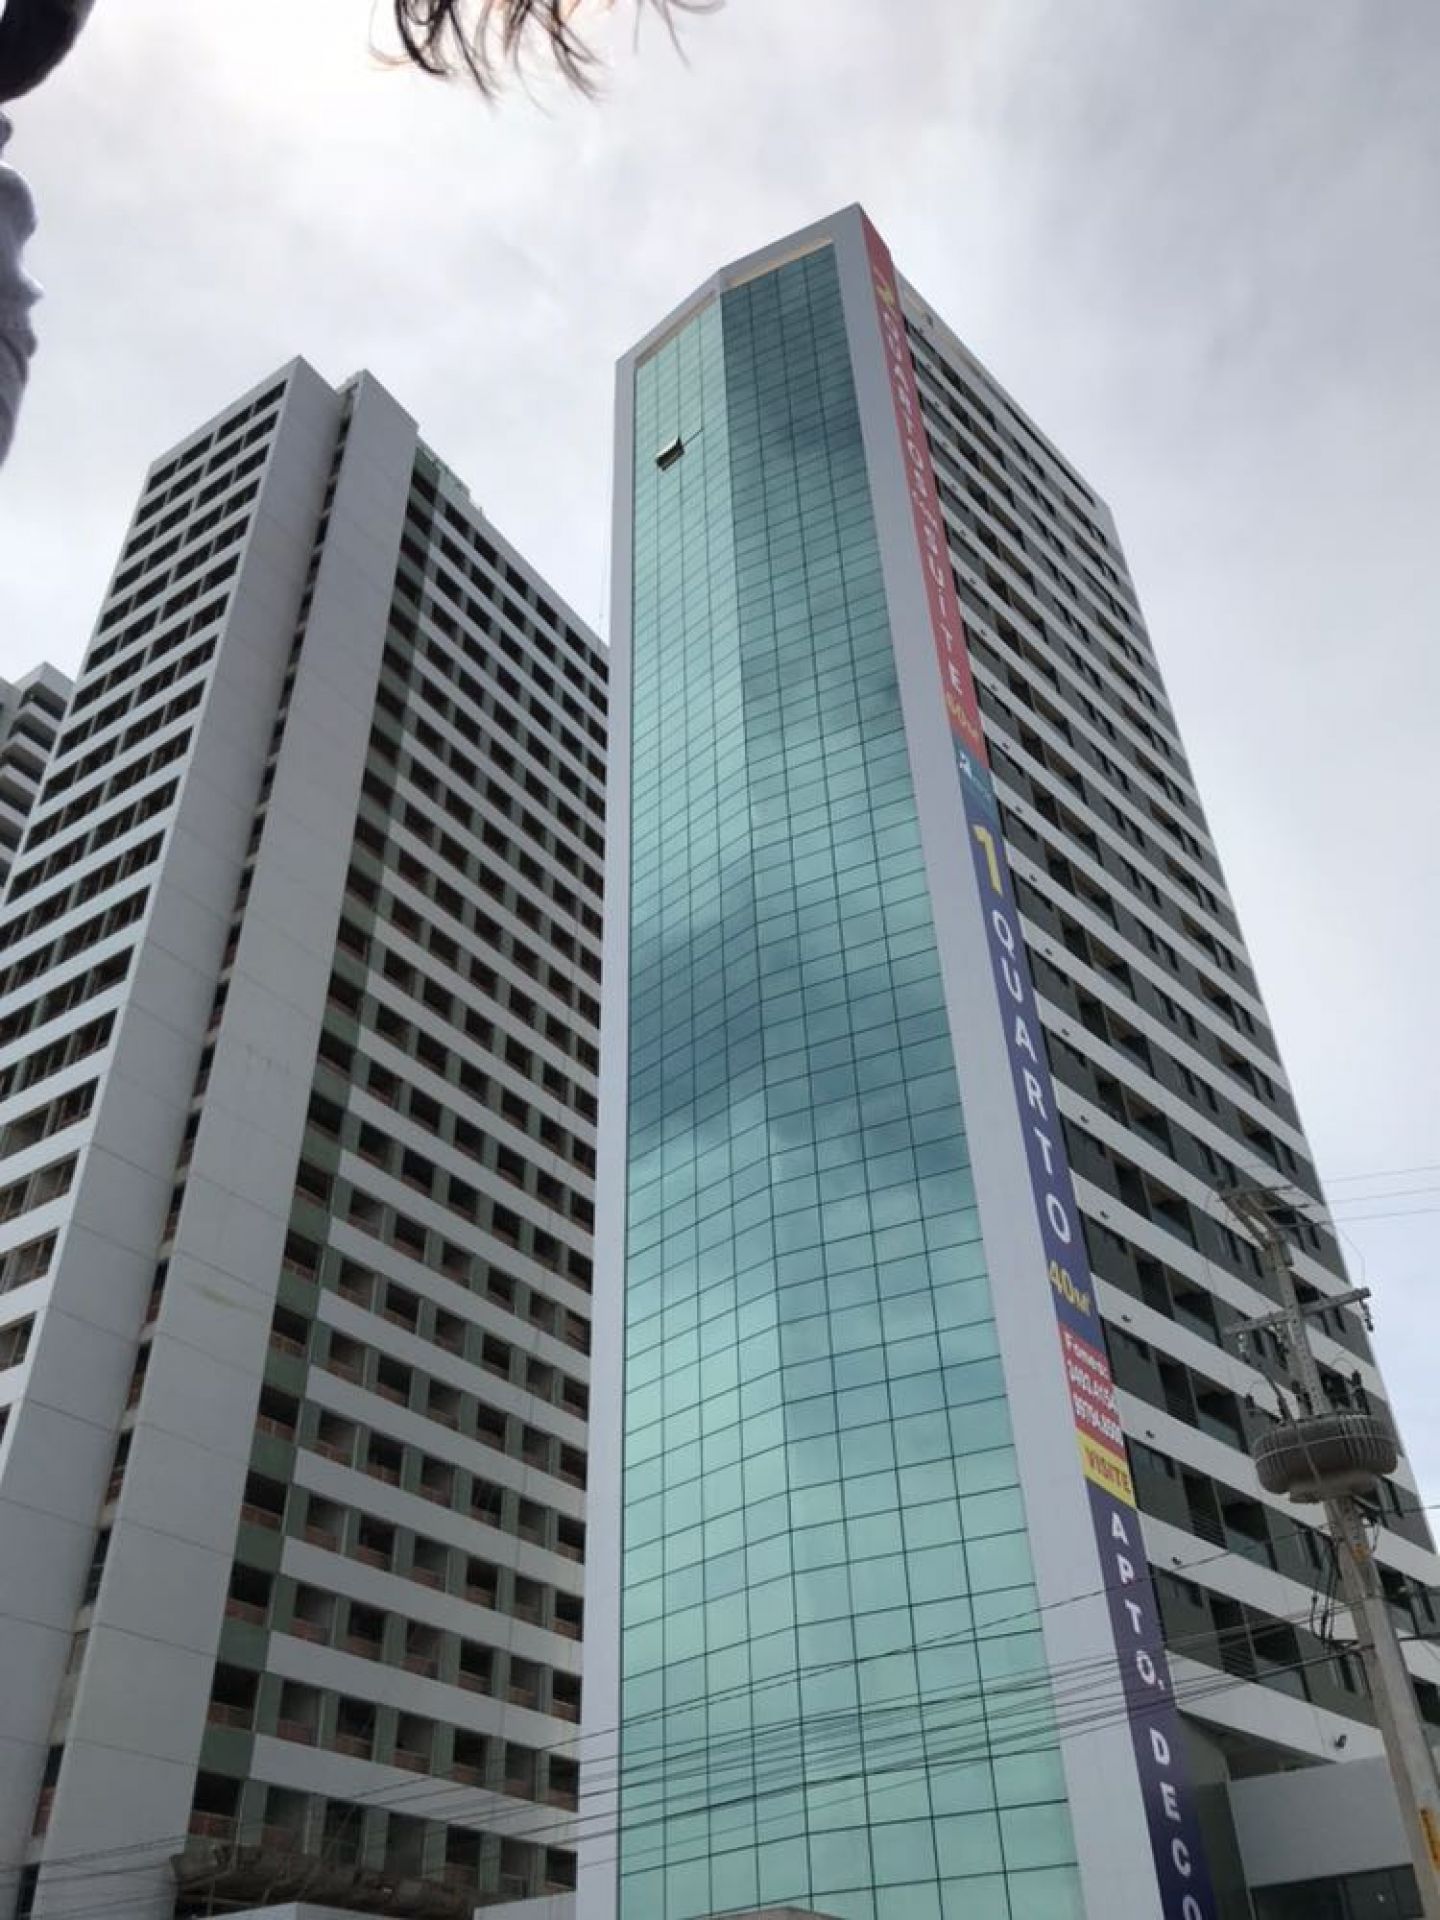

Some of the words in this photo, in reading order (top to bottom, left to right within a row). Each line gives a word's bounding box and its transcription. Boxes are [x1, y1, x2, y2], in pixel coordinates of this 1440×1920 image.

[972, 823, 1003, 896] 1
[991, 908, 1072, 1244] QUARTO
[1085, 1446, 1132, 1495] VISITE
